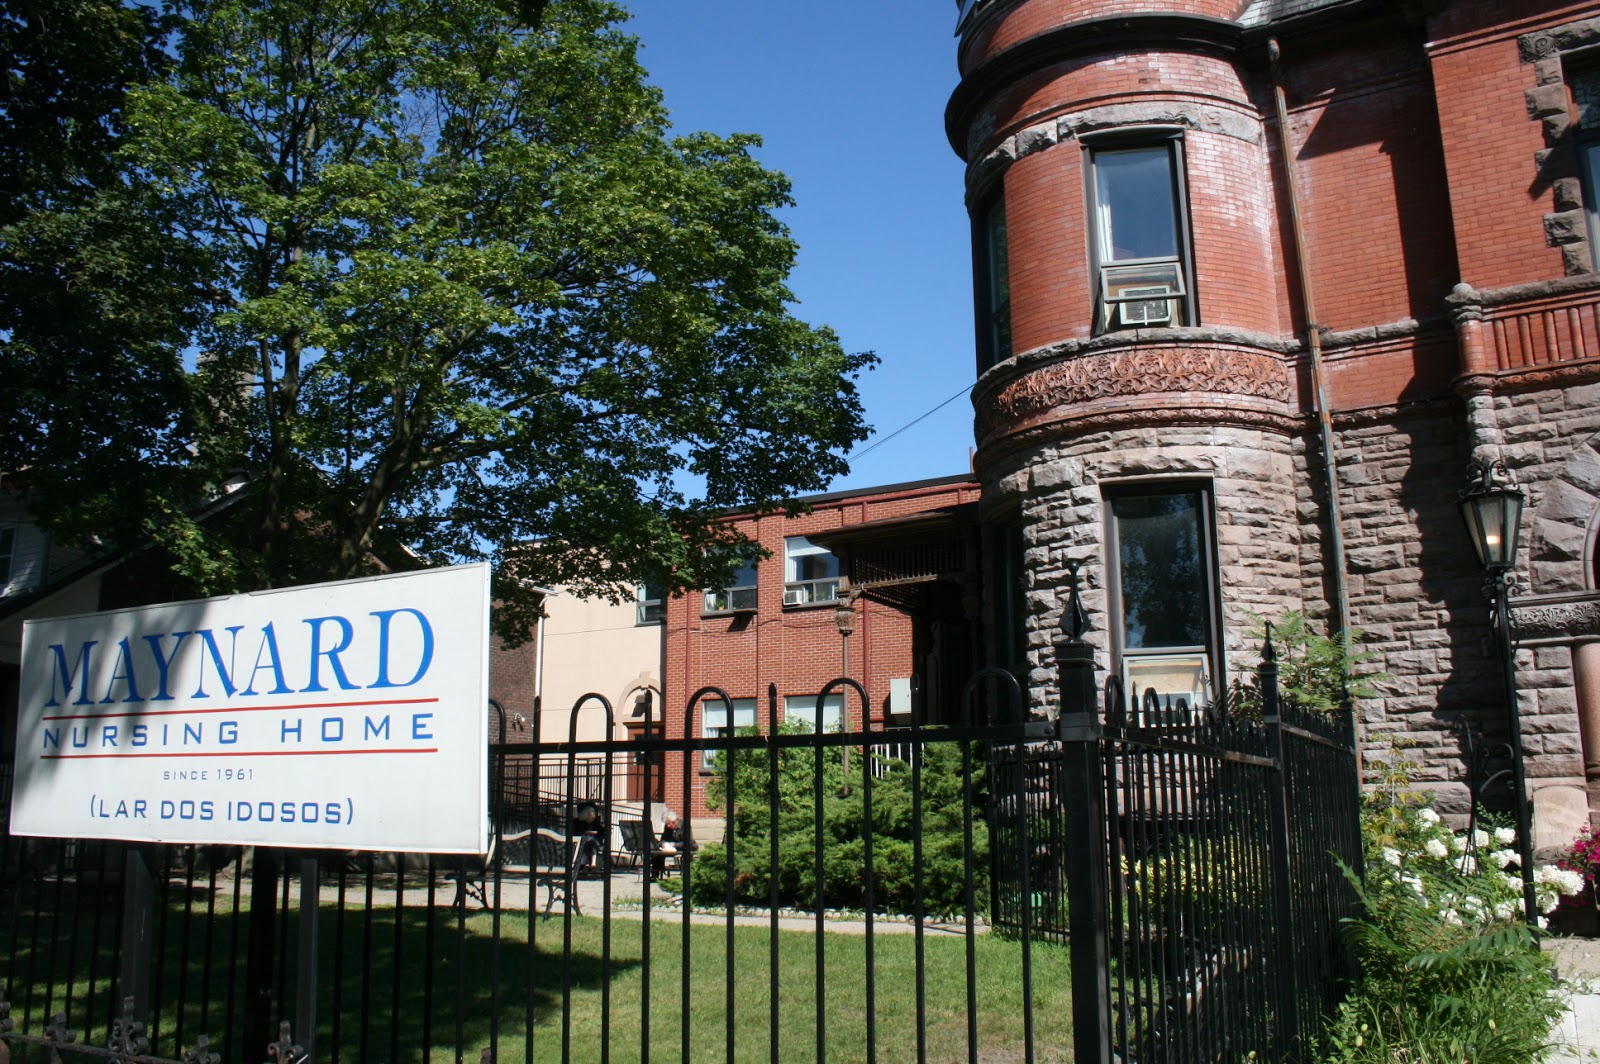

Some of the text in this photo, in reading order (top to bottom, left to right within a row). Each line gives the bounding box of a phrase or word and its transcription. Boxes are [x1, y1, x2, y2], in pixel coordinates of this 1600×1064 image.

[44, 607, 435, 707] MAYNARD
[43, 713, 434, 749] NURSING HOME
[163, 768, 254, 781] SINCE 1961
[90, 794, 354, 825] (LAR DOS IDOSOS)
